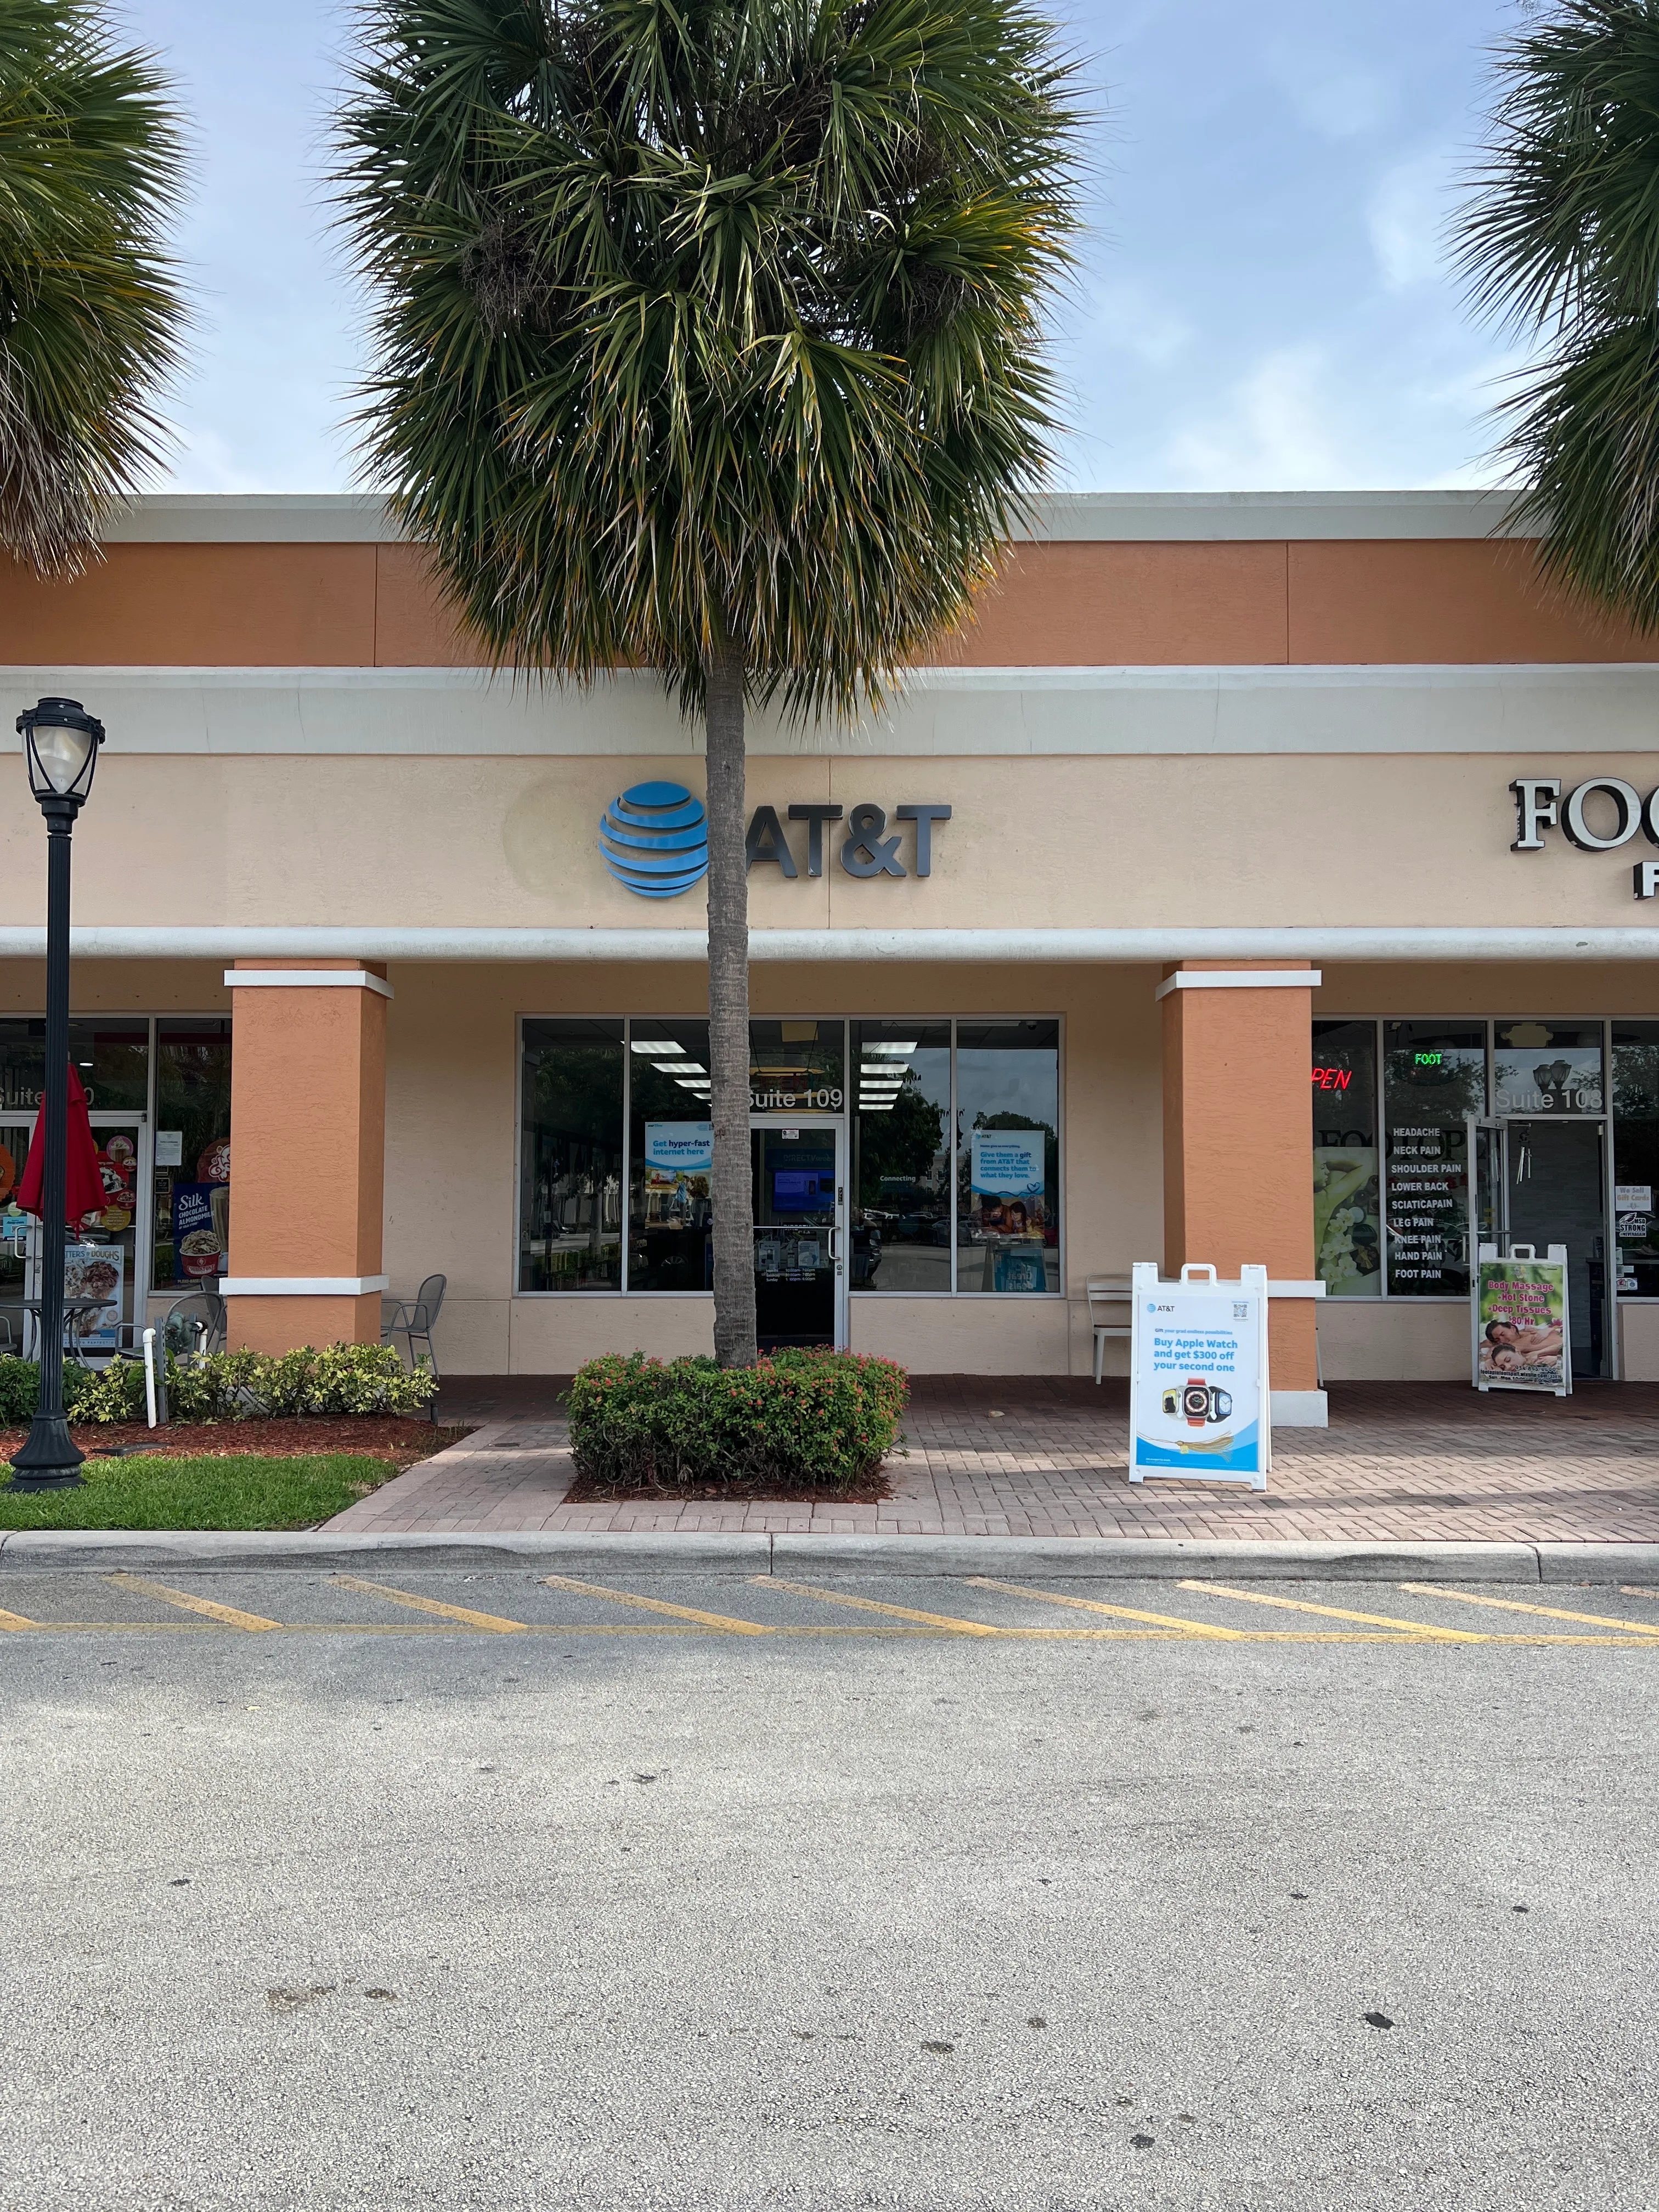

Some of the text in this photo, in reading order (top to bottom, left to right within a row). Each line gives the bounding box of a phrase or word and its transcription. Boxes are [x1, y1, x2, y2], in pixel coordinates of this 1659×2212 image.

[745, 804, 952, 878] AT&T
[1415, 1053, 1442, 1065] FOOT
[1311, 1068, 1352, 1090] PEN
[804, 1088, 843, 1108] 109
[1496, 1088, 1603, 1109] Suite 108
[1393, 1128, 1440, 1137] HEADACHE
[669, 1139, 710, 1148] hyper-fast
[1393, 1146, 1441, 1155] NECK PAIN
[1391, 1164, 1462, 1173] SHOULDER PAIN
[1392, 1182, 1449, 1191] LOWER BACK
[179, 1193, 205, 1210] Silk
[1392, 1199, 1453, 1209] SCIATICAPAIN
[179, 1205, 208, 1218] CHOCOLATE
[1393, 1218, 1434, 1227] LEG PAIN
[1395, 1235, 1441, 1244] KNEE PAIN
[91, 1250, 119, 1261] DOUGHS
[1395, 1252, 1442, 1260] HAND PAIN
[1395, 1269, 1441, 1278] FOOT PAIN
[1488, 1280, 1554, 1293] Body Massage
[1519, 1293, 1544, 1302] Stone
[1516, 1305, 1551, 1314] Tissues
[1154, 1338, 1238, 1349] Buy Apple Watch
[1154, 1350, 1234, 1360] and get $300 off
[1154, 1362, 1177, 1370] your
[1179, 1362, 1214, 1370] second
